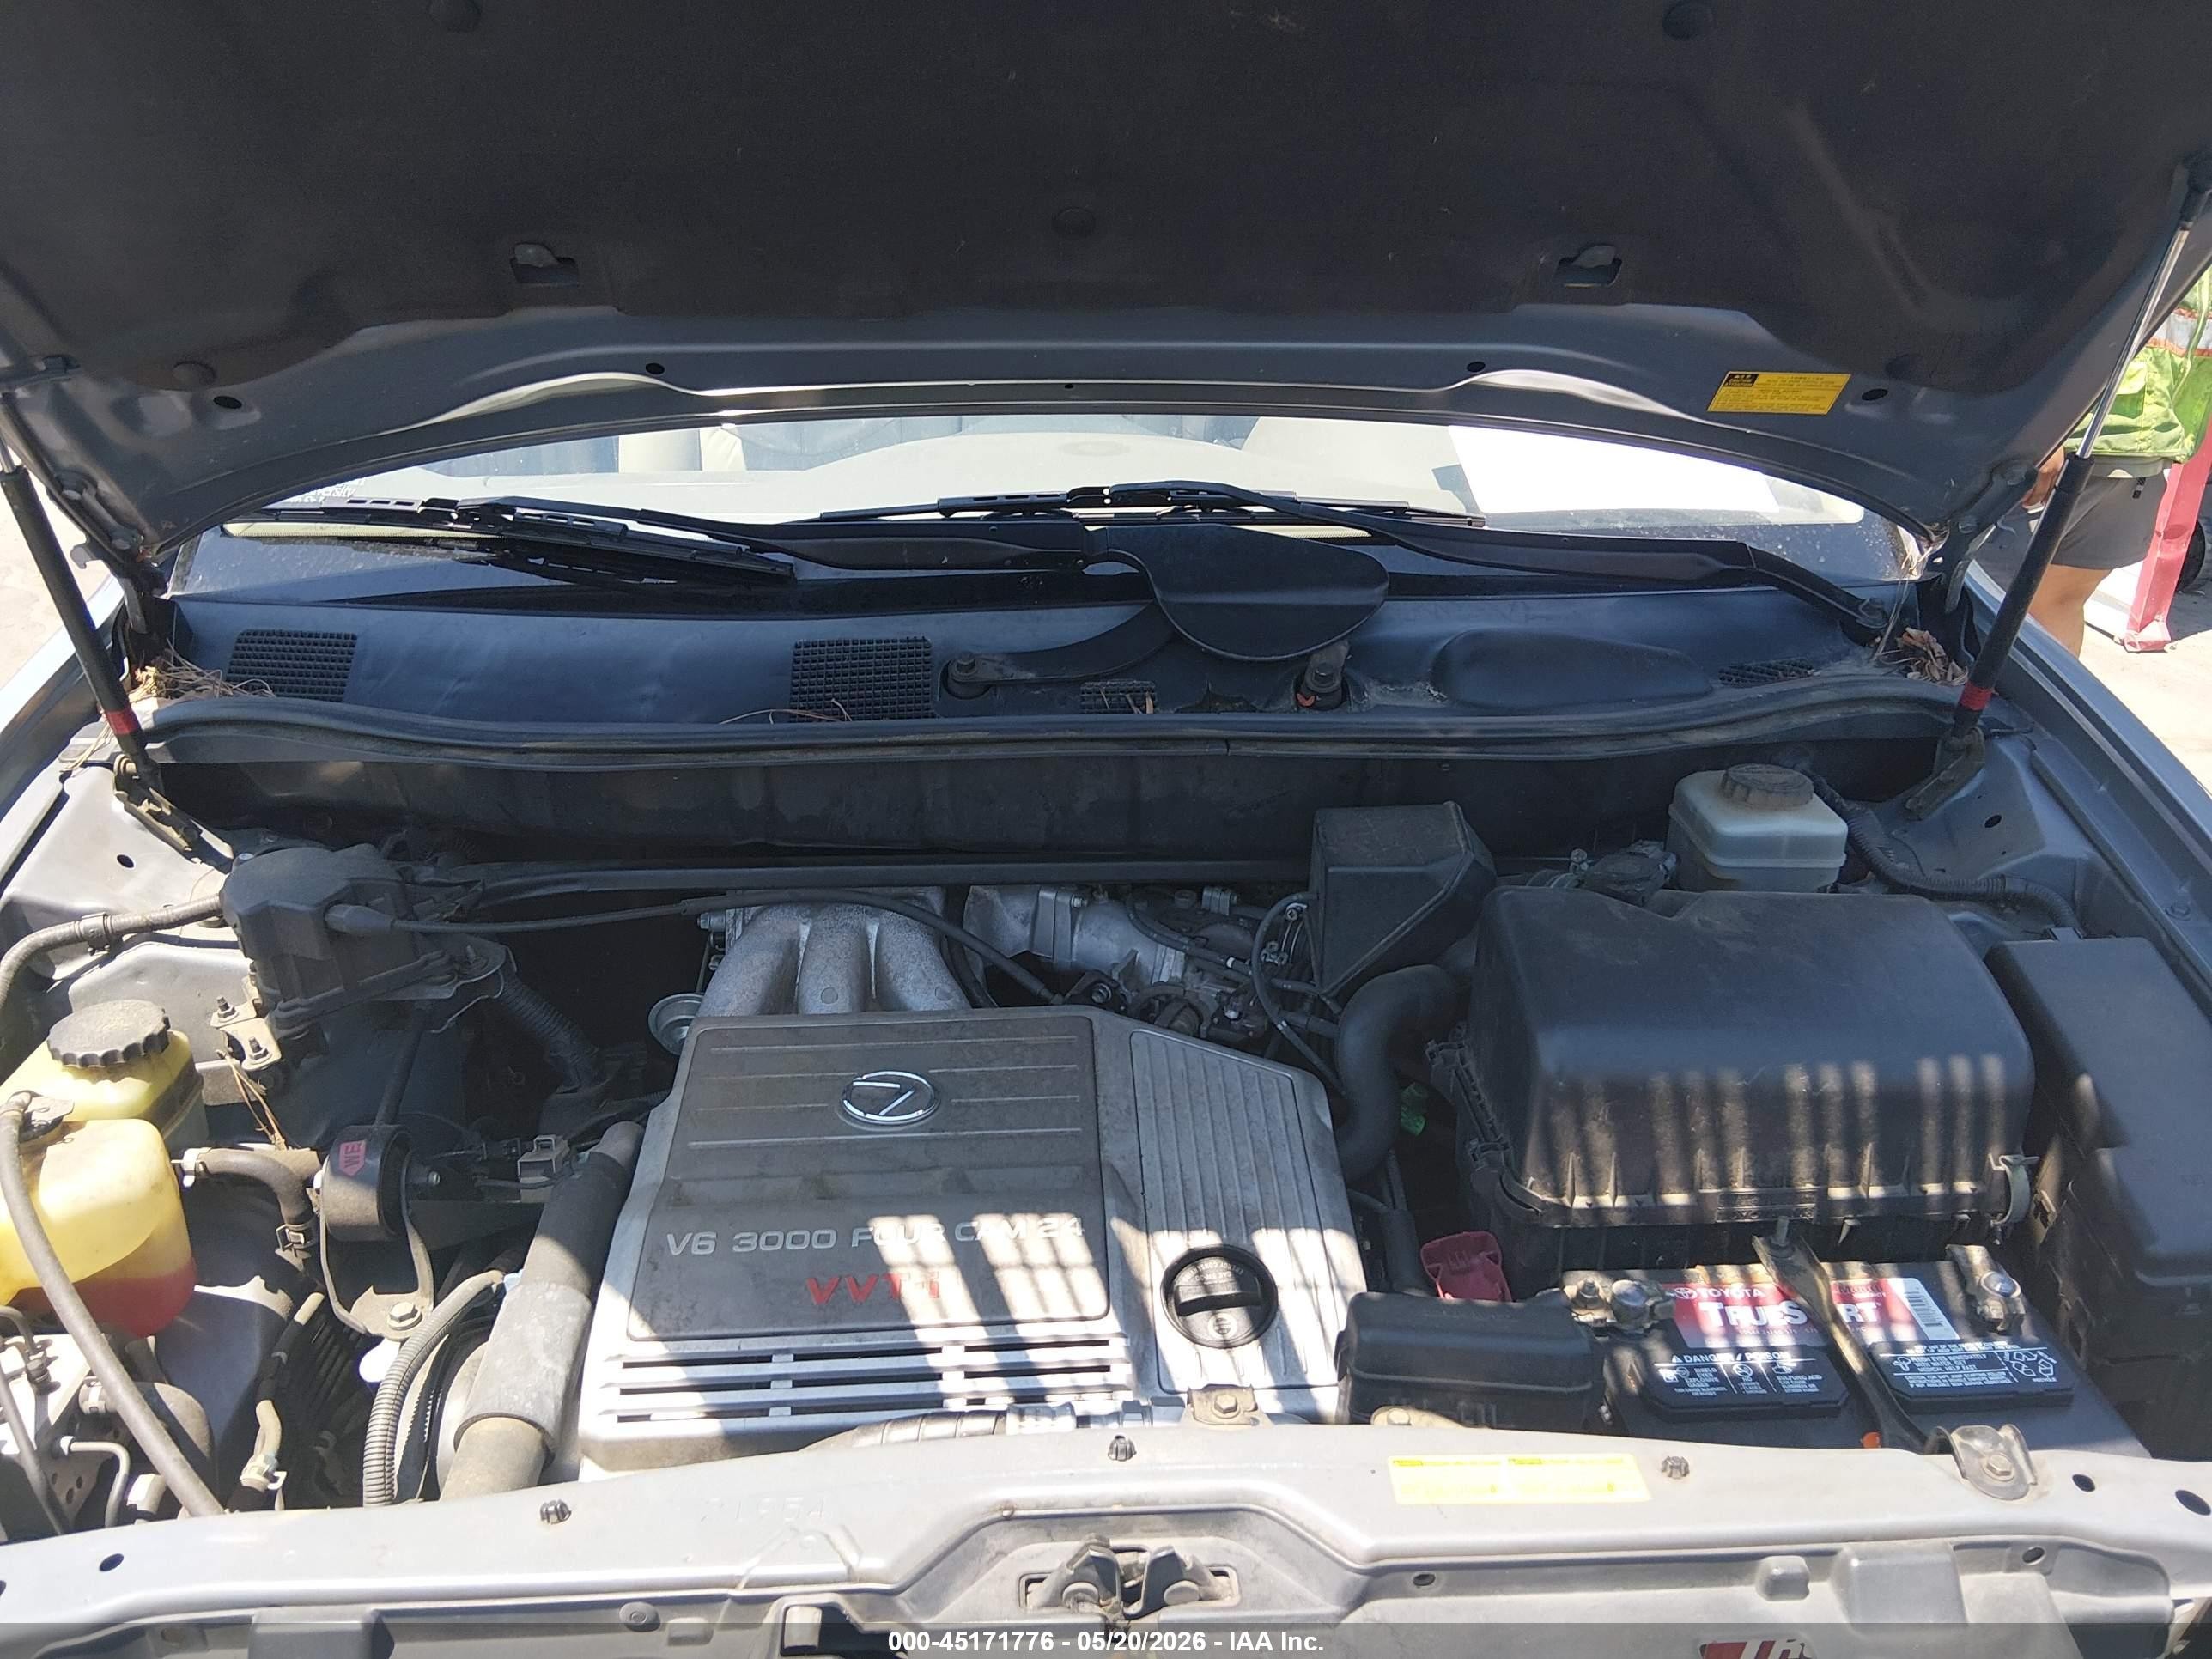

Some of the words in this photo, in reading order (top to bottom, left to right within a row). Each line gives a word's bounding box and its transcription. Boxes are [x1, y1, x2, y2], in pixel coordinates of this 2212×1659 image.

[666, 1231, 718, 1256] V6
[732, 1228, 838, 1253] 3000
[851, 1222, 947, 1248] FOUR
[954, 1220, 1027, 1243] CAM
[1036, 1217, 1084, 1238] 24
[1696, 1287, 1766, 1299] TOYOTA
[1684, 1353, 1735, 1364] DANGER
